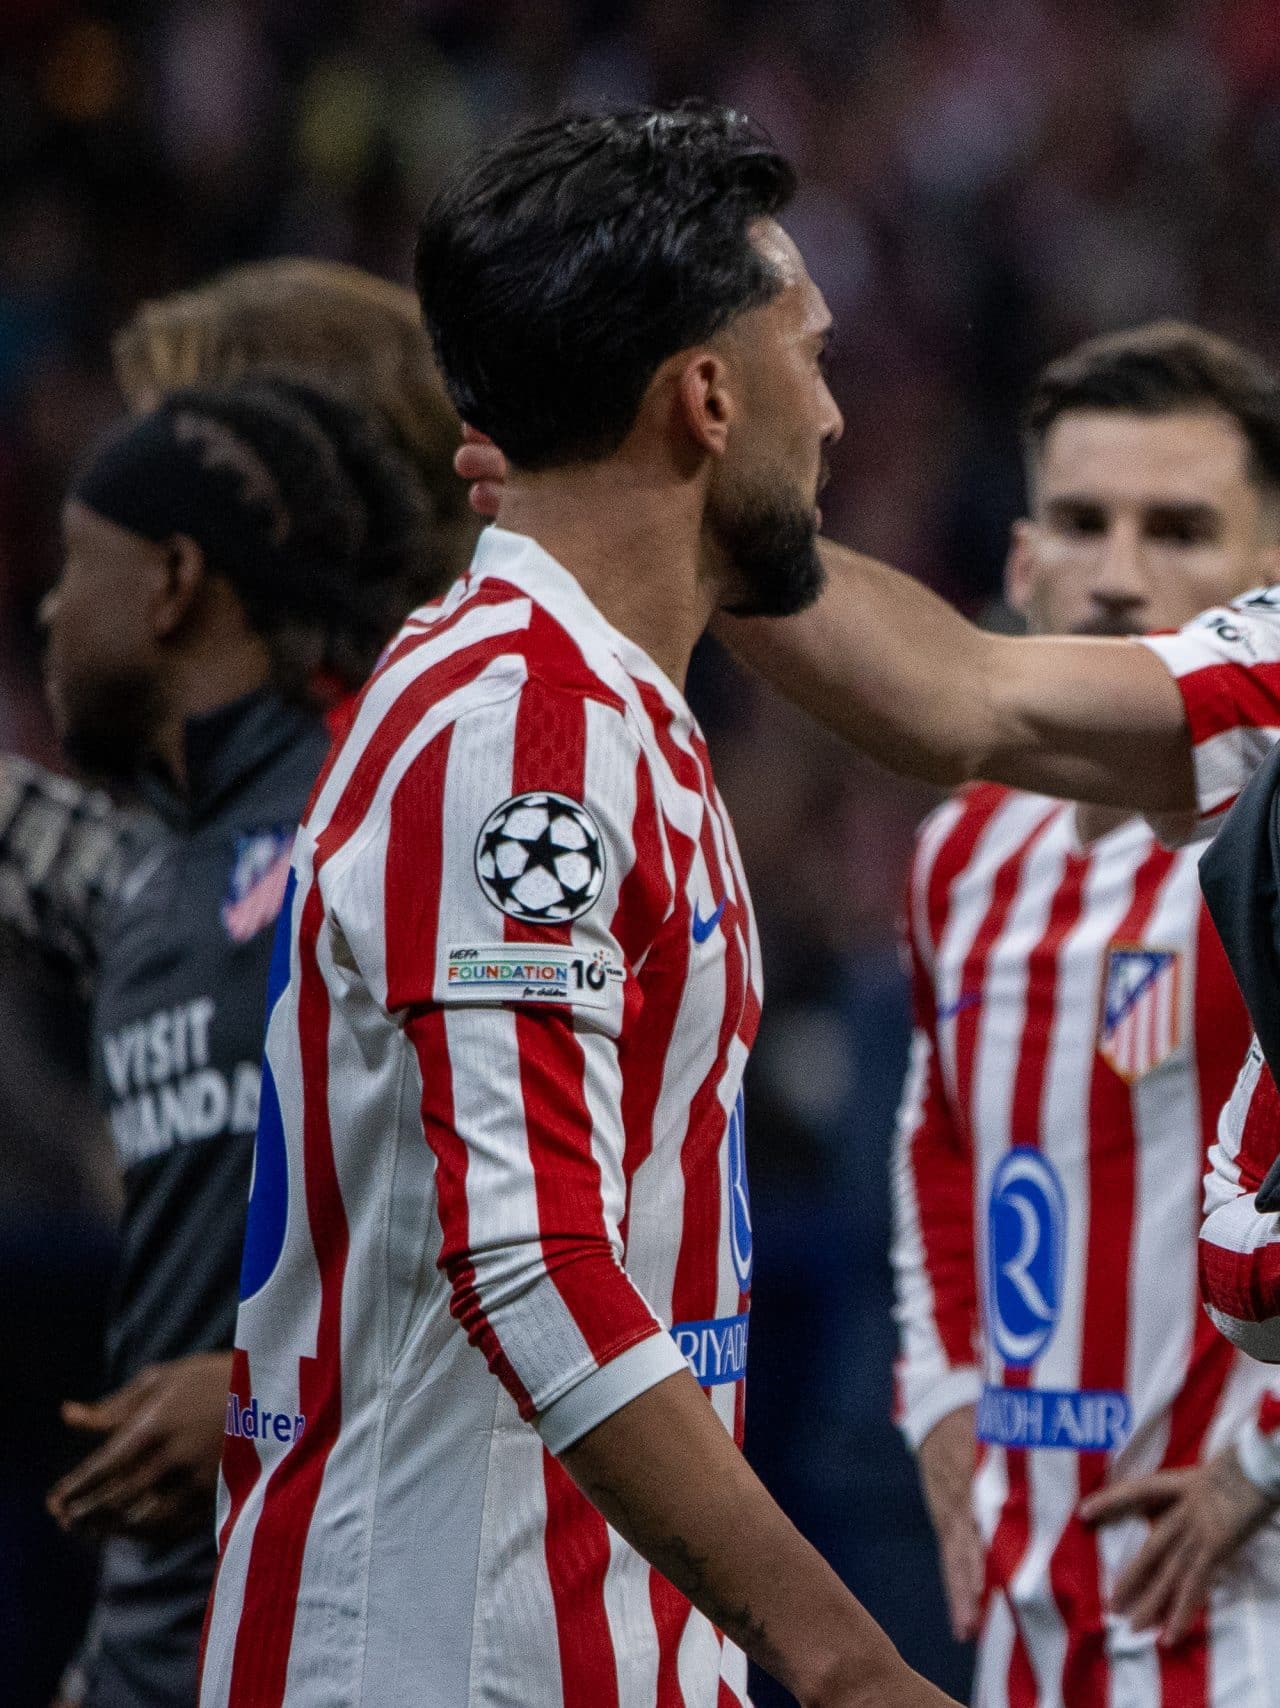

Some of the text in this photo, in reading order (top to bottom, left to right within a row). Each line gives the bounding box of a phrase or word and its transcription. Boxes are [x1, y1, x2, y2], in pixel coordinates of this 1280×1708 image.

[449, 949, 479, 960] UEFA
[447, 964, 568, 981] FOUNDATION
[571, 959, 606, 990] 10
[102, 996, 215, 1098] VISIT
[1053, 1396, 1132, 1453] AIR
